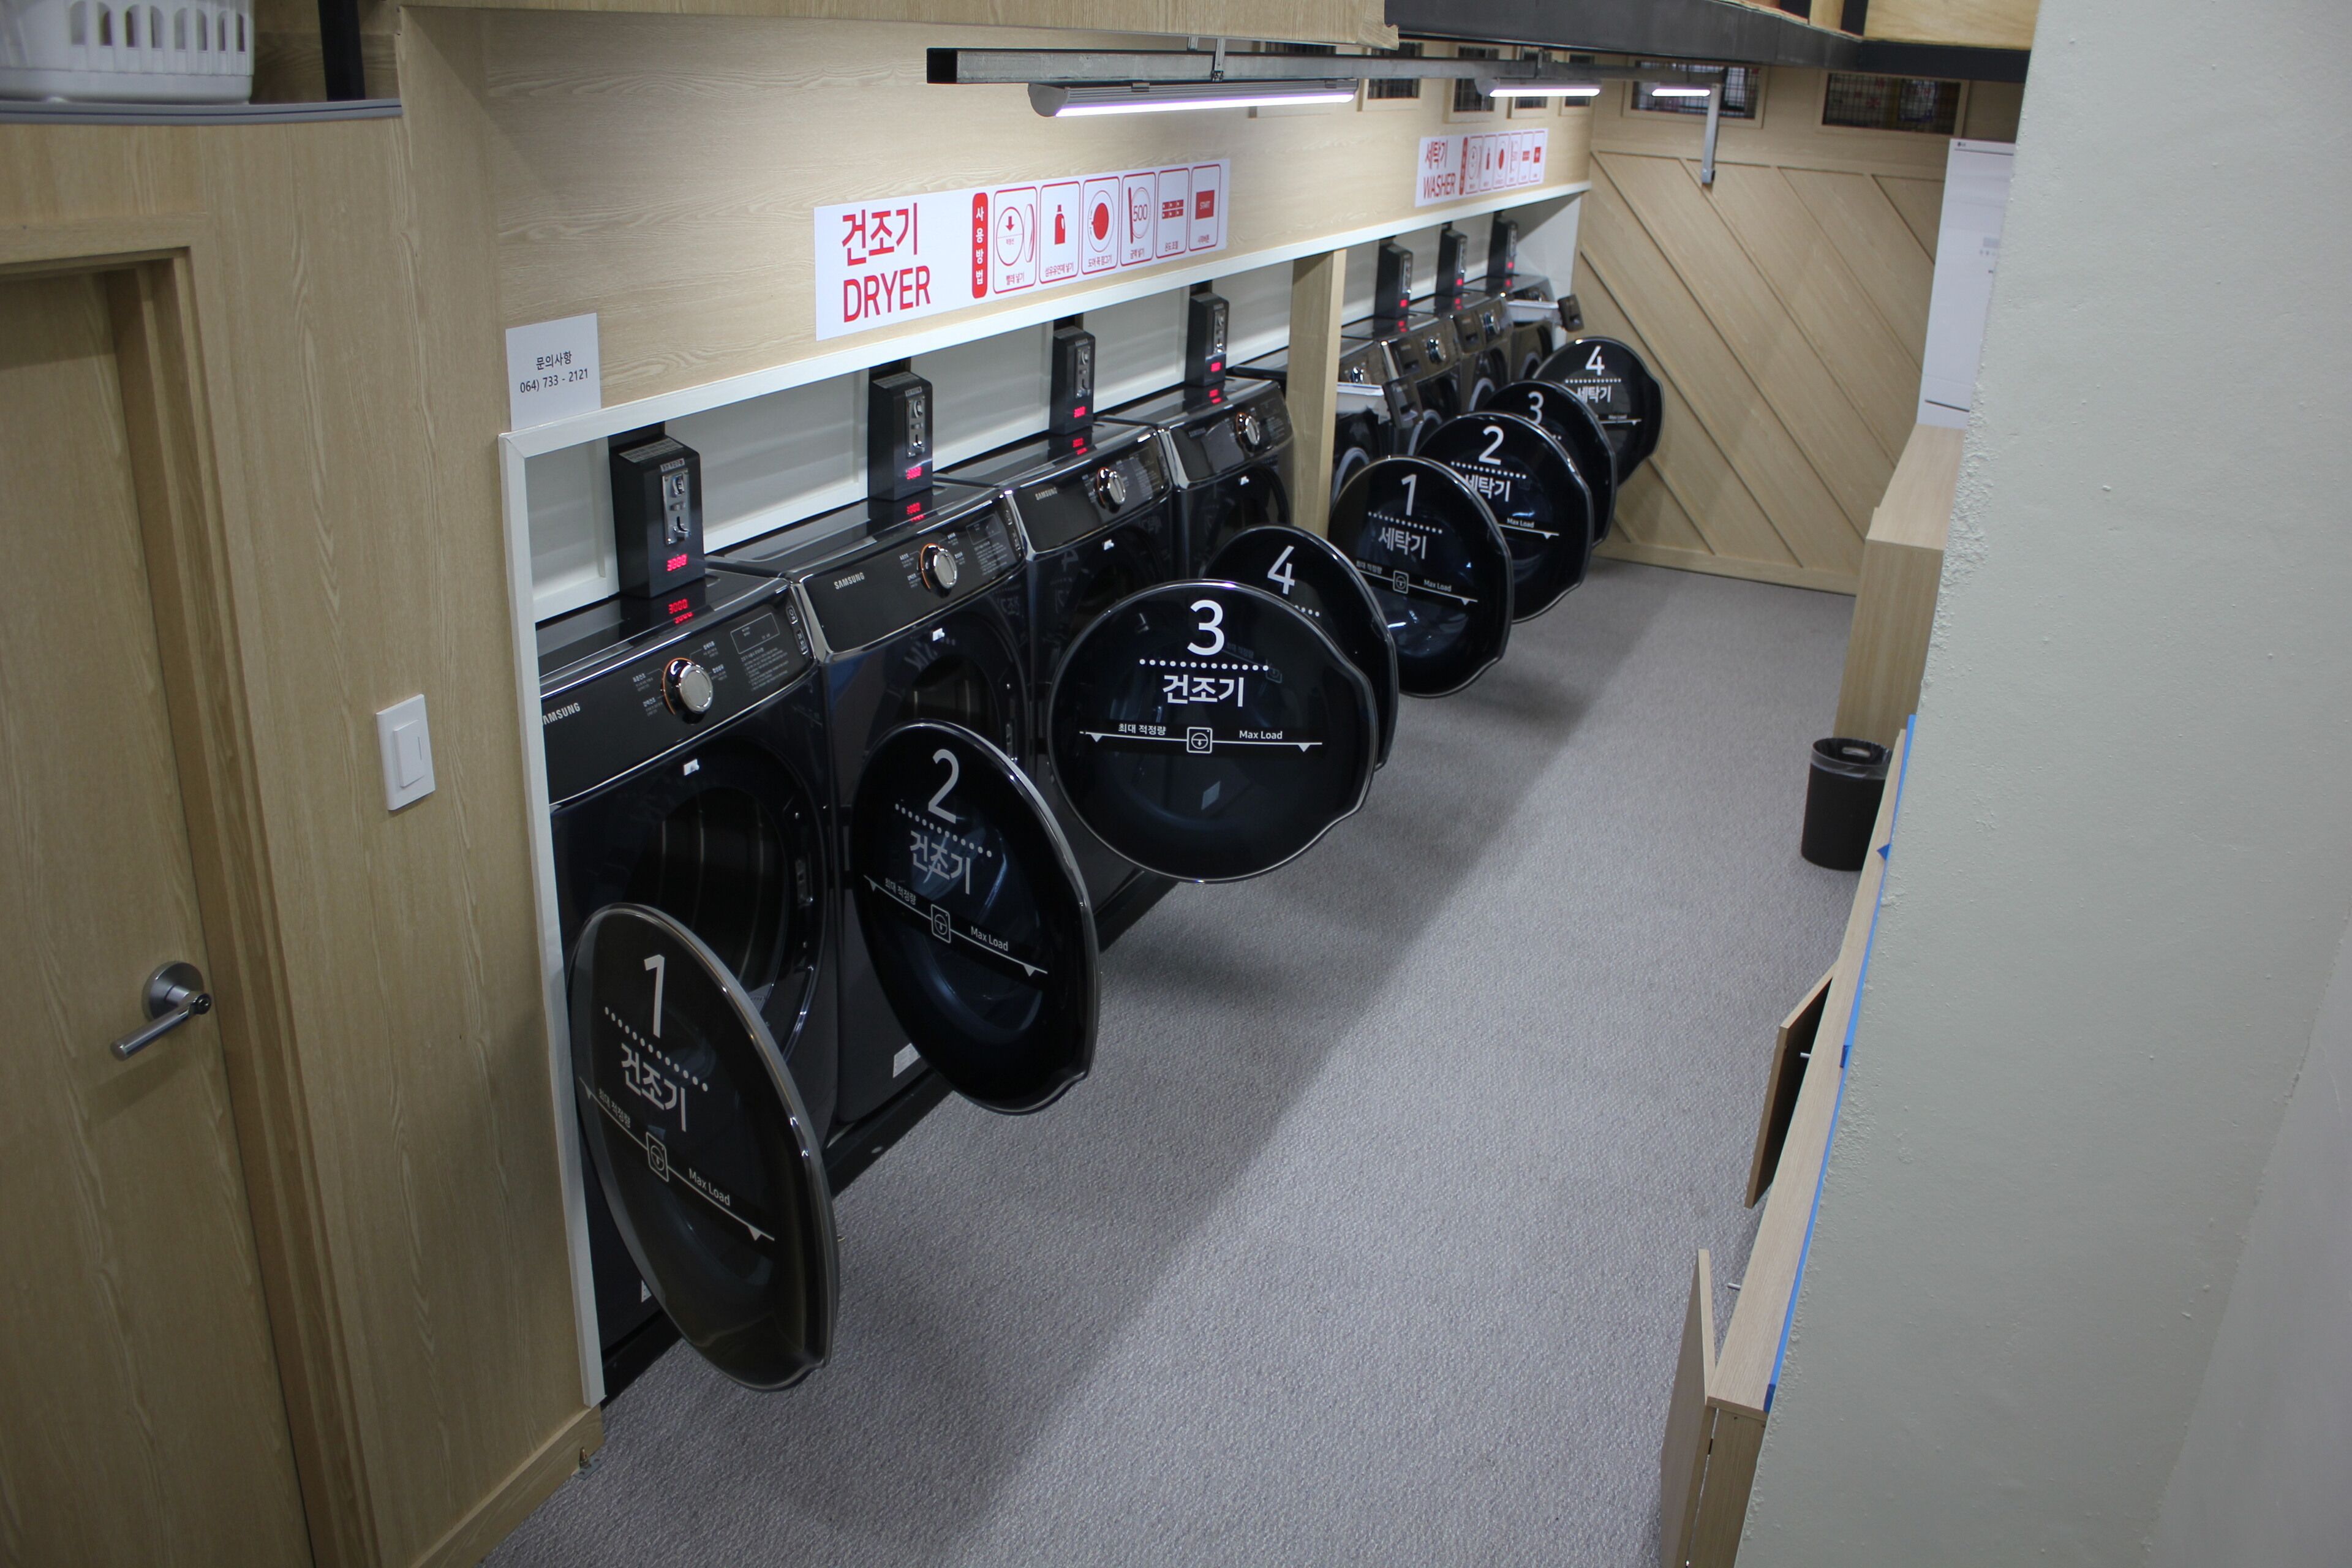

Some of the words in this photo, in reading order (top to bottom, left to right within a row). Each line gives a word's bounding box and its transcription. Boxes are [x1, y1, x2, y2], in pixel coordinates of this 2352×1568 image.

[1425, 140, 1448, 169] 세탁기
[1423, 173, 1456, 199] WASHER
[1133, 204, 1148, 222] 500
[842, 202, 918, 266] 건조기
[843, 265, 931, 323] DRYER
[536, 350, 572, 371] 문의사항
[1585, 345, 1605, 376] 4
[520, 379, 540, 393] 064)
[543, 375, 559, 388] 733
[568, 368, 588, 383] 2121
[1577, 386, 1611, 403] 세탁기
[1528, 391, 1544, 424] 3
[1478, 425, 1504, 466] 2
[1035, 487, 1058, 501] SAMSUNG
[1401, 473, 1417, 516] 1
[1466, 474, 1510, 502] 세탁기
[1378, 527, 1427, 559] 세탁기
[834, 571, 865, 590] SAMSUNG
[1267, 545, 1295, 595] 4
[1423, 579, 1436, 590] Max
[1437, 582, 1452, 592] Load
[1187, 599, 1226, 656] 3
[1163, 674, 1245, 707] 건조기
[542, 703, 581, 726] AMSUNG
[1118, 723, 1136, 734] 최대
[1138, 724, 1166, 736] 적정량
[1239, 729, 1259, 740] Max
[1261, 730, 1283, 741] Load
[927, 748, 960, 824] 2
[910, 830, 971, 895] 건조기
[884, 878, 896, 895] 최대
[897, 886, 916, 905] 적정량
[971, 925, 987, 942] Max
[989, 935, 1009, 951] Load
[644, 954, 665, 1039] 1
[621, 1042, 687, 1133] 건조기
[689, 1167, 707, 1189] Max
[709, 1182, 731, 1206] Load
